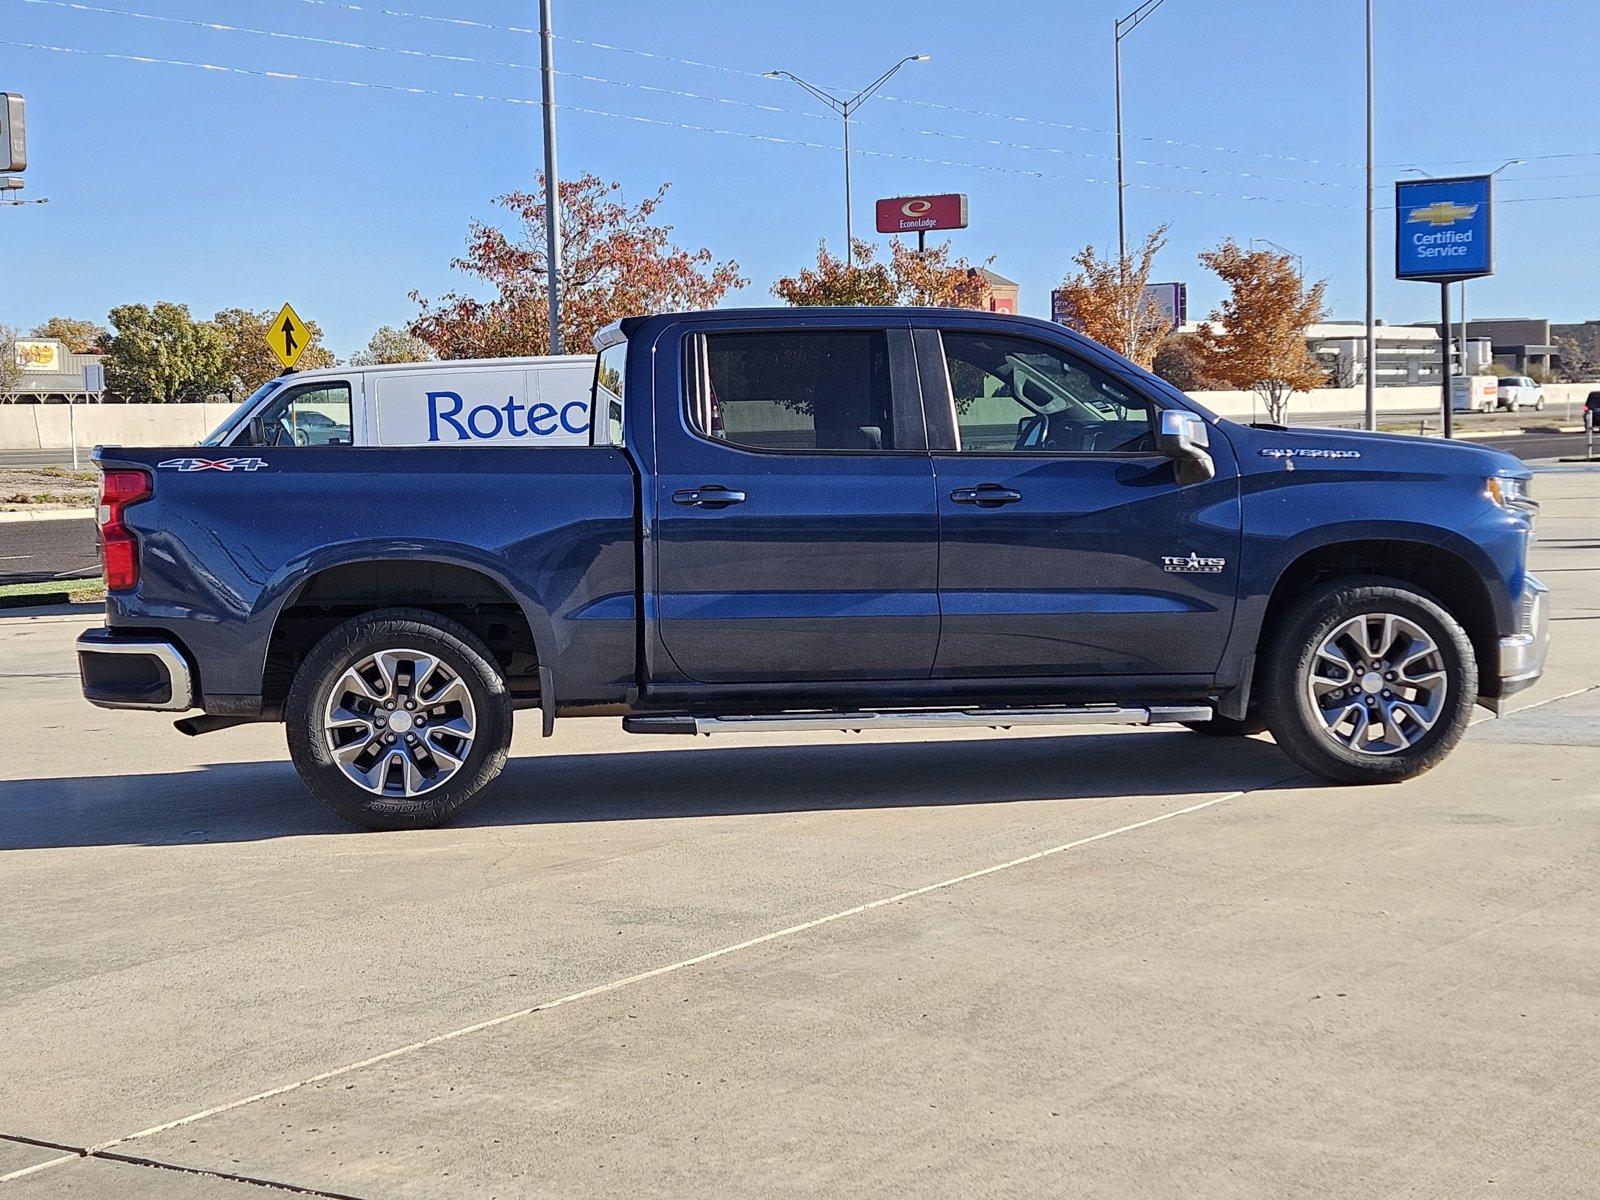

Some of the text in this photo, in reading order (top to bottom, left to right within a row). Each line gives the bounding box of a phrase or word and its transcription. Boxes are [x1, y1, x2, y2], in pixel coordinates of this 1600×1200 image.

[1413, 229, 1473, 245] Certified
[1417, 244, 1468, 258] Service
[425, 390, 592, 442] Rotec
[1261, 448, 1361, 458] SILVERADO
[1161, 552, 1226, 567] TEXAS
